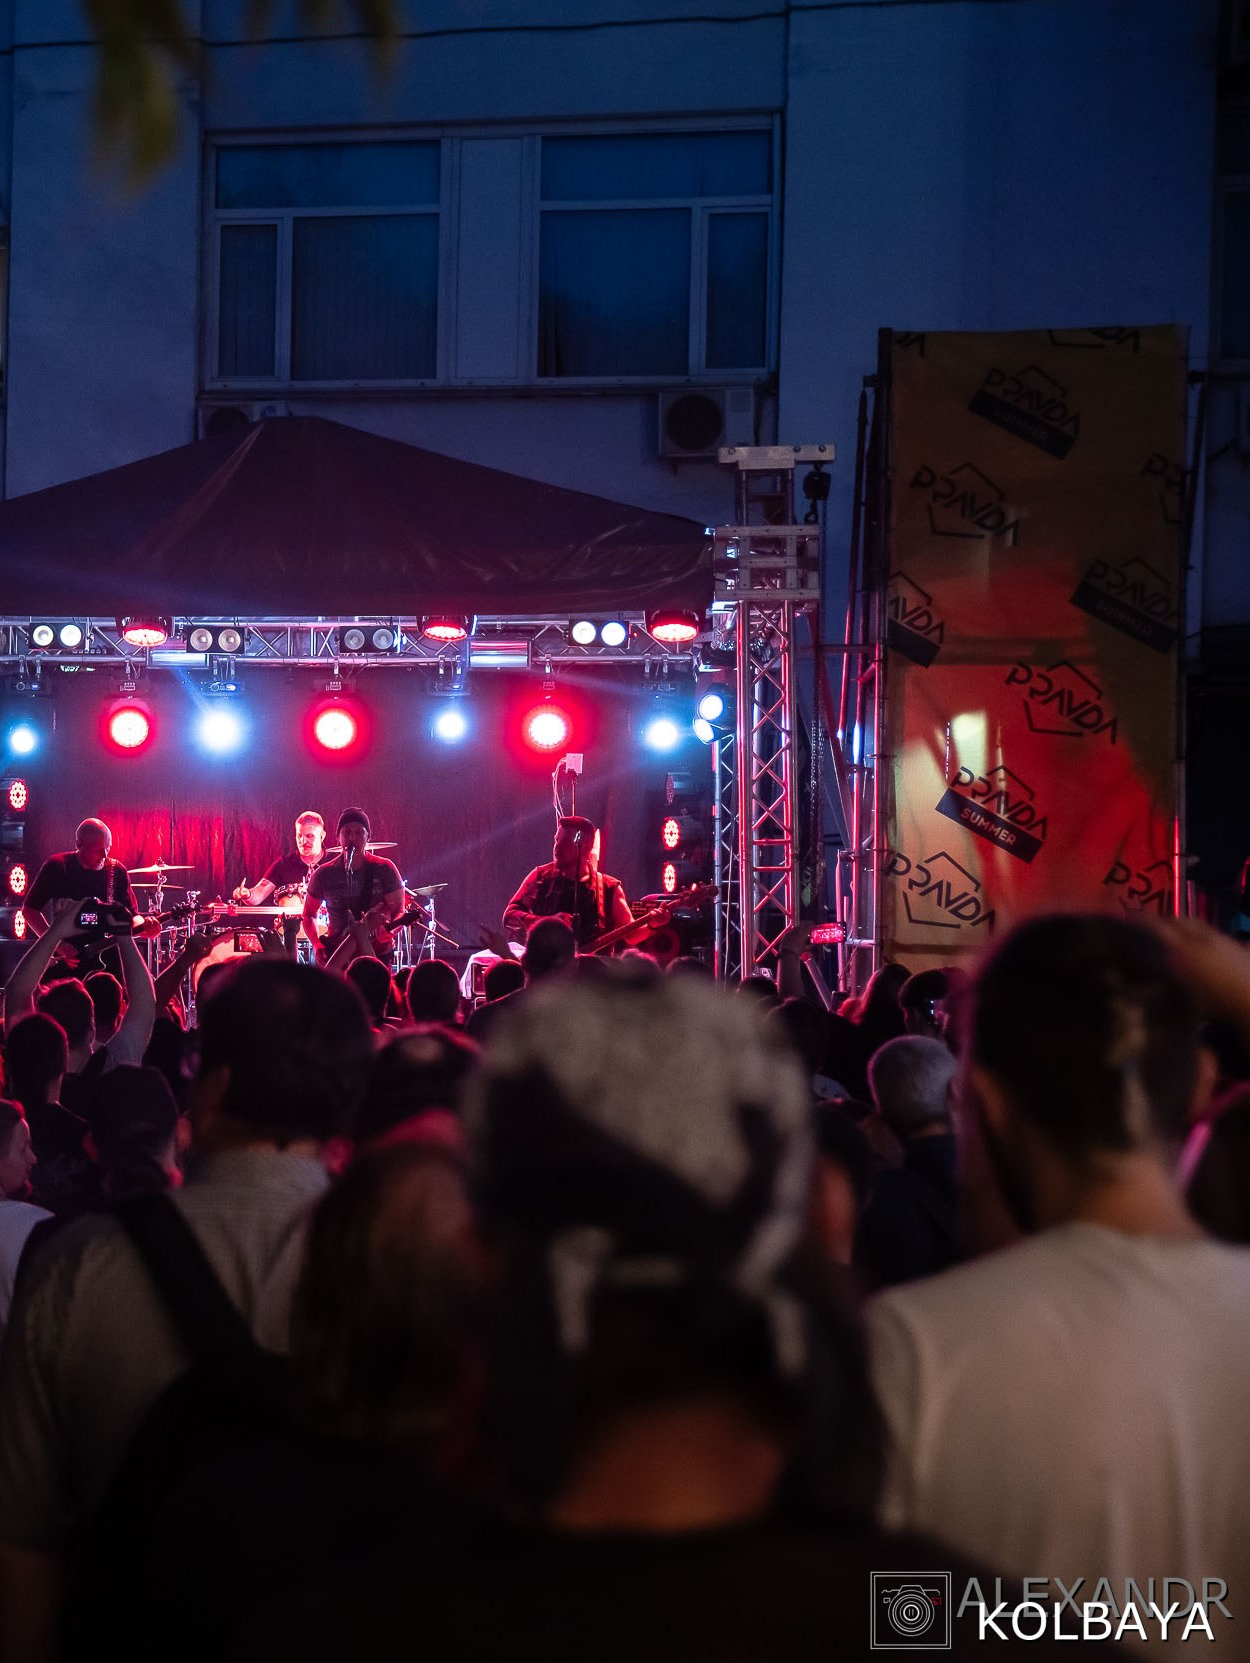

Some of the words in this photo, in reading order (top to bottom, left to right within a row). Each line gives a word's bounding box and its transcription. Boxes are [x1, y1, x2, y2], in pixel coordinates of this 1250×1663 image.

[979, 367, 1080, 435] PRAVDA
[910, 465, 1020, 546] PRAVDA
[888, 596, 944, 644] AVDA
[1004, 662, 1119, 744] PRAVDA
[951, 766, 1048, 840] PRAVDA
[960, 807, 1017, 846] SUMMER
[884, 852, 996, 936] PRAVDA
